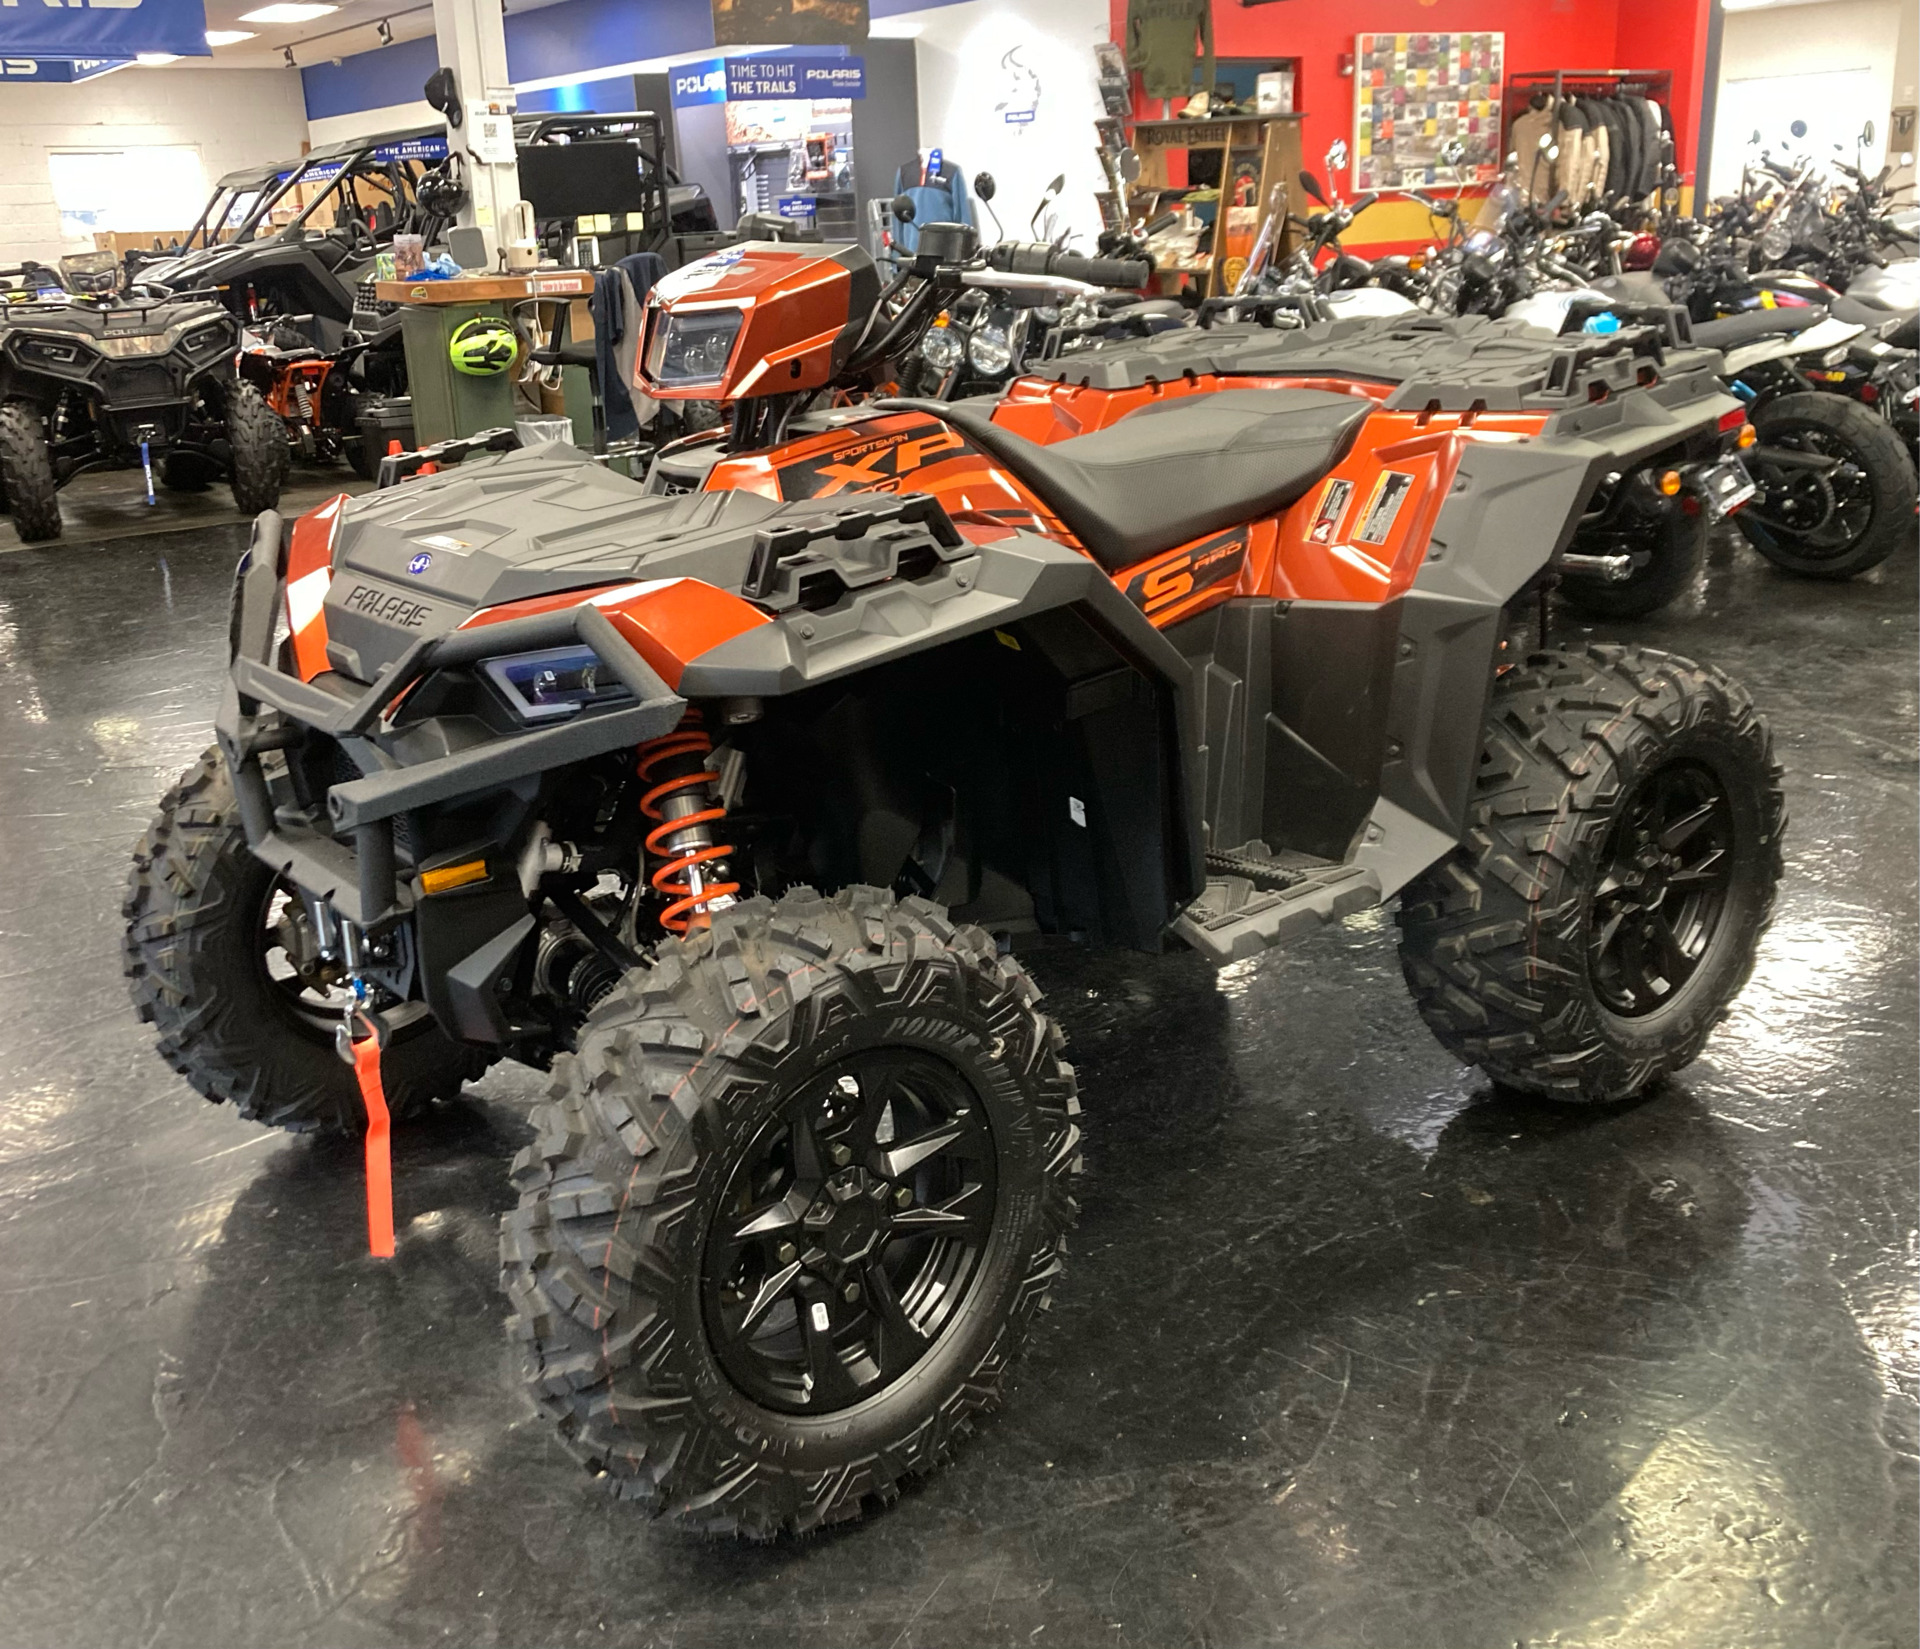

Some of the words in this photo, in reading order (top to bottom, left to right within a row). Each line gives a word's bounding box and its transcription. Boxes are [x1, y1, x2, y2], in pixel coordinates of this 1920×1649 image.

[730, 64, 758, 78] TIME
[759, 64, 775, 77] TO
[776, 64, 795, 77] HIT
[806, 69, 862, 80] POLARIS
[731, 81, 755, 94] THE
[755, 80, 797, 94] TRAILS
[1147, 127, 1184, 146] ROYAL
[384, 147, 400, 156] THE
[401, 145, 440, 155] AMERICAN
[103, 327, 153, 337] POLAR
[833, 433, 909, 461] SPORTSMAN
[814, 431, 965, 499] XP
[1142, 555, 1194, 613] S
[344, 585, 433, 627] POLARIS
